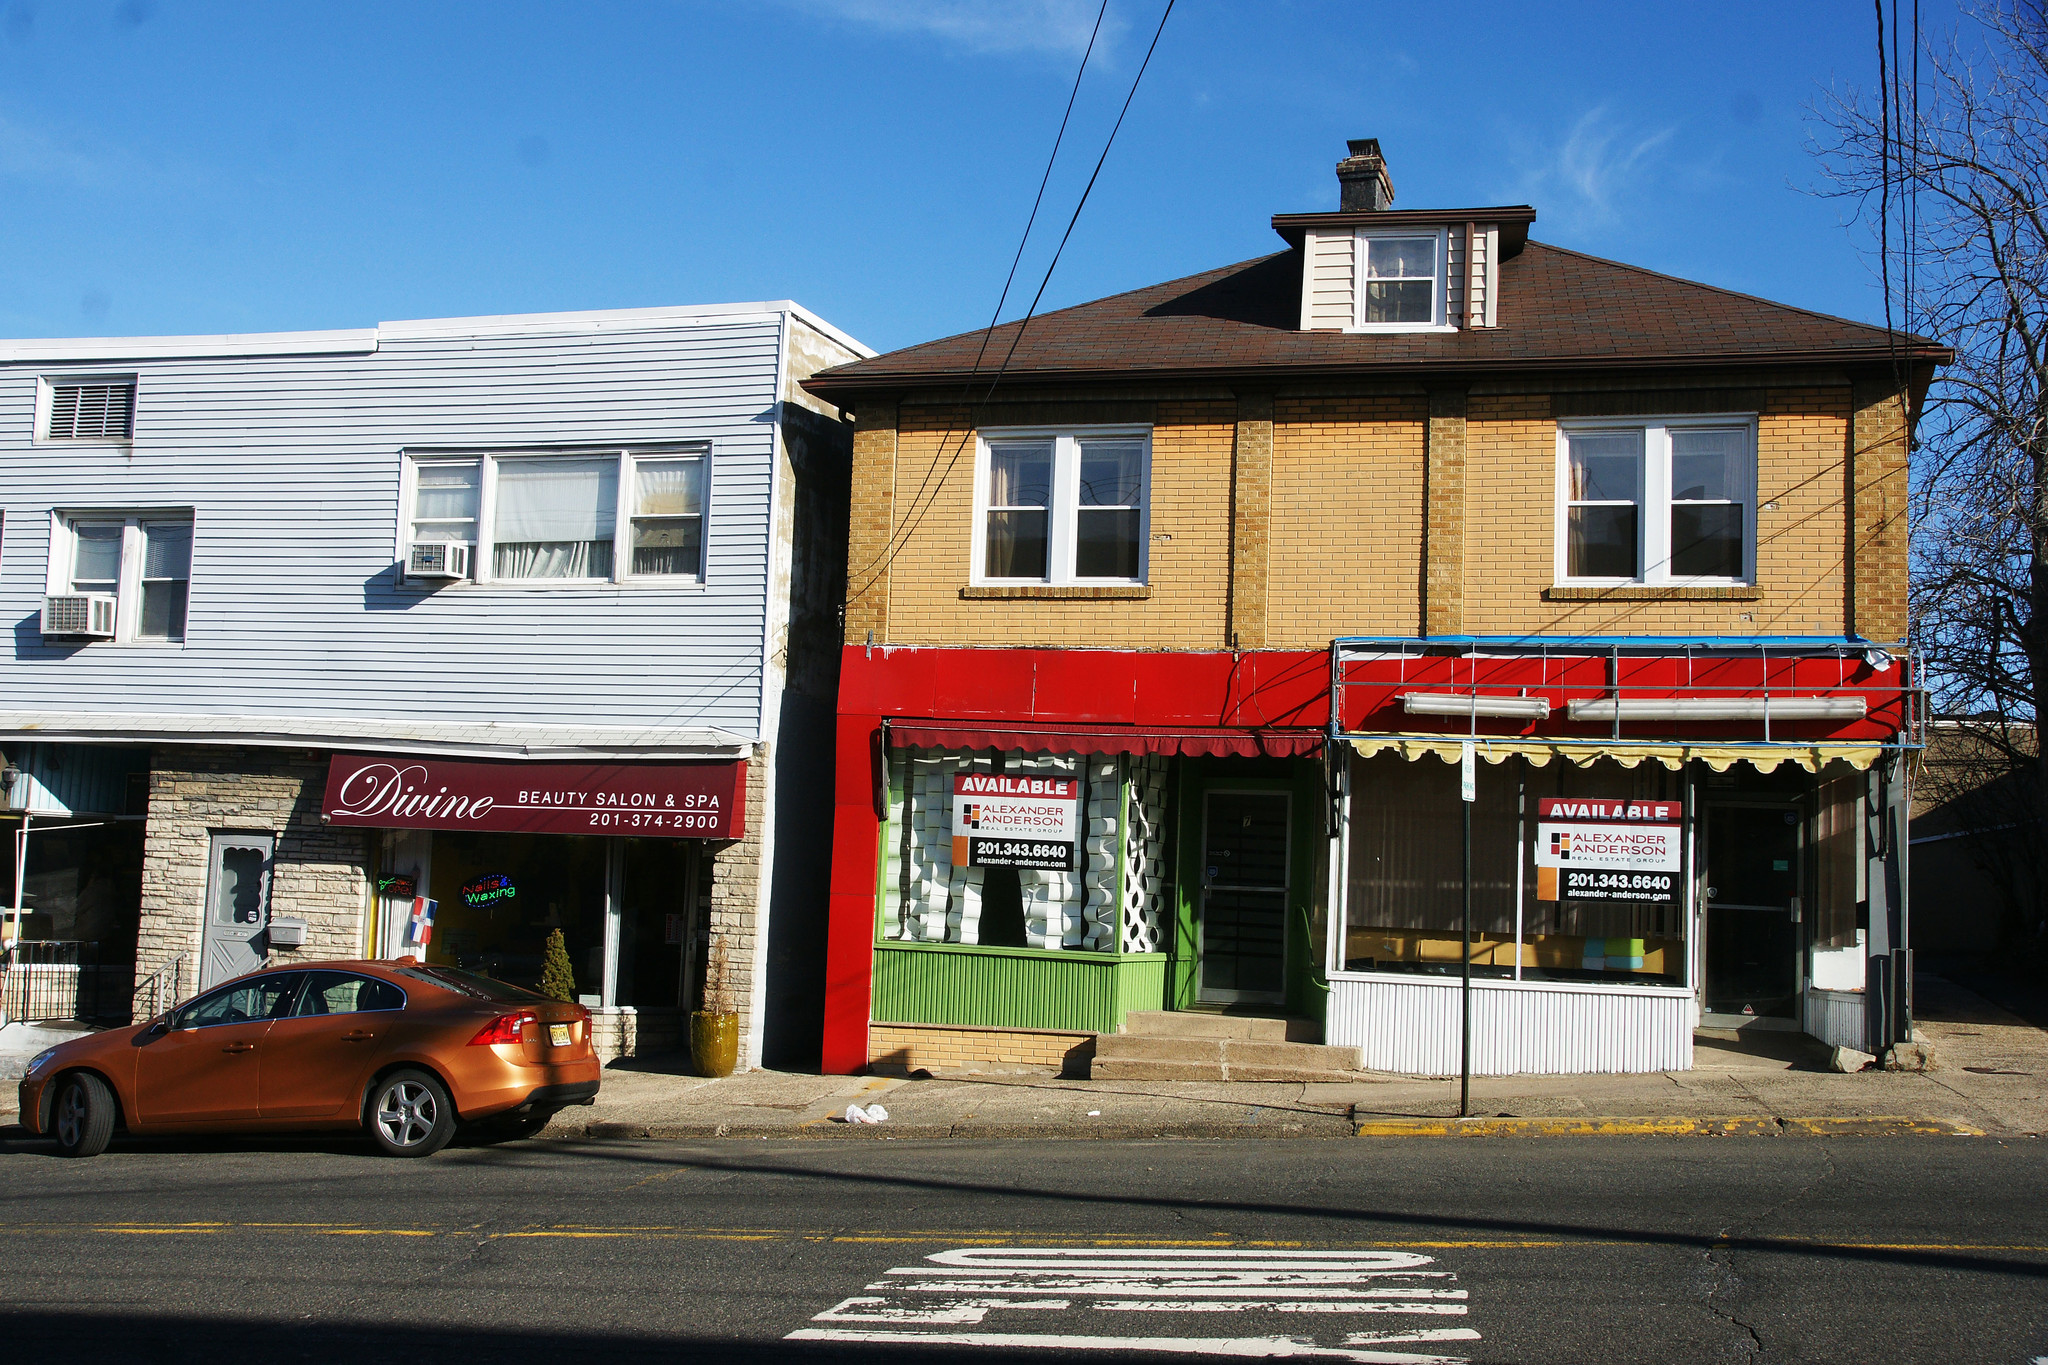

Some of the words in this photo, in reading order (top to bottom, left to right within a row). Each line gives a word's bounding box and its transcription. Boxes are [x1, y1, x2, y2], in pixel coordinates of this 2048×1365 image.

[331, 763, 494, 820] Divine
[962, 777, 1068, 795] AVAILABLE
[518, 790, 588, 806] BEAUTY
[595, 792, 657, 807] SALON
[664, 794, 675, 807] &
[685, 794, 720, 809] SPA
[982, 804, 1064, 816] ALEXANDER
[1549, 803, 1669, 821] AVAILABLE
[589, 812, 719, 829] 201-374-2900
[982, 815, 1063, 827] ANDERSON
[1572, 833, 1666, 845] ALEXANDER
[977, 841, 1067, 858] 201.343.6640
[1572, 844, 1666, 855] ANDERSON
[976, 857, 1067, 868] alexander-anderson.com
[462, 880, 499, 895] Nails
[1568, 872, 1671, 890] 201.343.6640
[466, 886, 516, 903] Waxing
[1567, 889, 1671, 901] alexander-anderson.com
